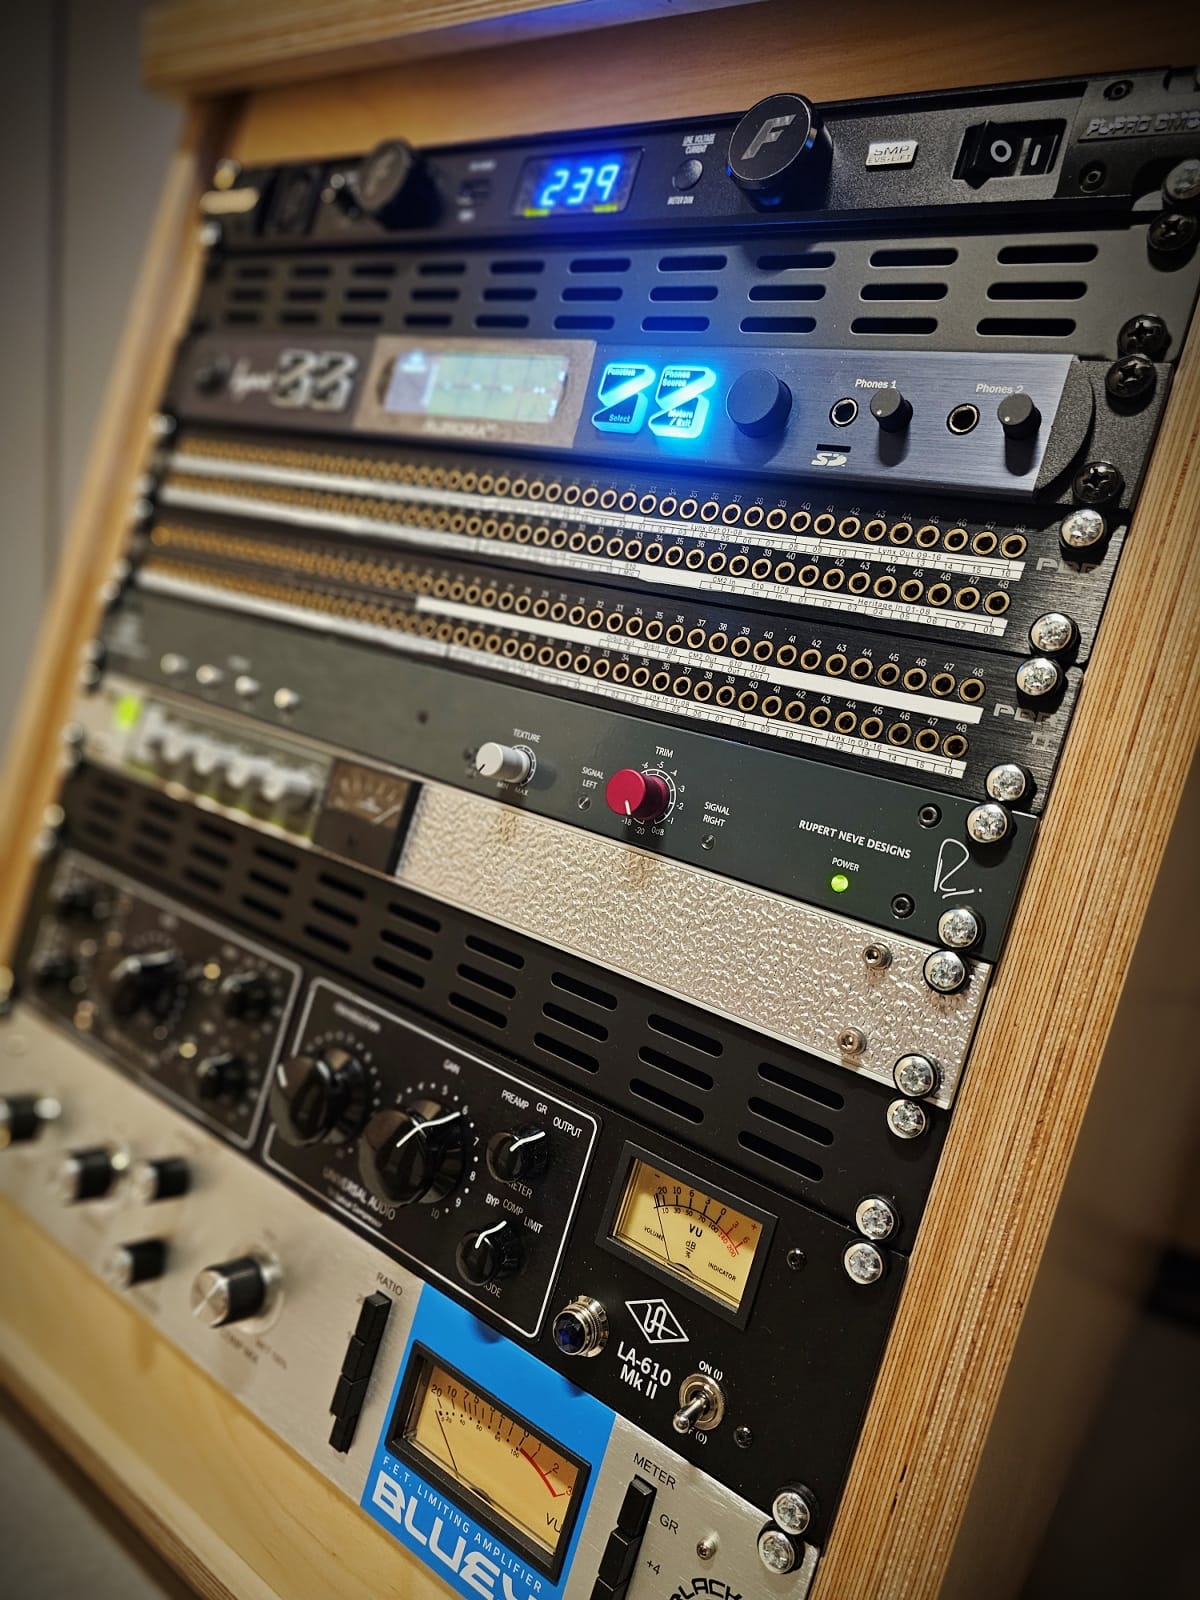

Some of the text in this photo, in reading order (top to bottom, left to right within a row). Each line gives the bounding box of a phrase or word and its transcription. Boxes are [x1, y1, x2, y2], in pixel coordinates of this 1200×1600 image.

[540, 163, 620, 207] 239
[855, 378, 897, 390] Phones 1
[975, 384, 1024, 394] Phones 2
[608, 414, 631, 422] Select
[850, 508, 860, 516] 42
[876, 510, 886, 519] 43
[902, 512, 912, 522] 44
[986, 522, 996, 530] 47
[878, 546, 898, 557] Lynx
[900, 550, 914, 559] Out
[696, 540, 705, 548] 36
[740, 546, 750, 554] 38
[763, 549, 772, 558] 39
[786, 552, 796, 560] 40
[812, 555, 820, 564] 41
[834, 558, 845, 568] 42
[860, 562, 870, 571] 43
[886, 564, 896, 574] 44
[912, 568, 924, 578] 45
[940, 572, 951, 582] 46
[968, 576, 980, 585] 47
[998, 580, 1009, 588] 48
[858, 599, 892, 610] Heritage
[676, 614, 984, 678] 36 37 38 39 40 41 42 43 44 45 46 47 48
[704, 655, 718, 663] Out
[662, 662, 968, 733] 36 37 38 39 40 41 42 43 44 45 46 47 48
[513, 728, 541, 743] TEXTURE
[655, 746, 674, 759] TRIM
[656, 760, 664, 769] -5
[582, 766, 604, 780] SIGNAL
[582, 779, 598, 790] LEFT
[678, 785, 685, 793] -3
[676, 802, 684, 810] -2
[704, 802, 730, 816] SIGNAL
[702, 814, 726, 828] RIGHT
[634, 826, 646, 836] -20
[651, 826, 665, 836] 0dB
[798, 819, 912, 860] RUPERT NEVE DESIGNS
[831, 856, 860, 872] POWER
[462, 1106, 469, 1116] 6
[501, 1089, 583, 1139] PREAMP GR OUTPUT
[474, 1137, 480, 1147] 7
[470, 1170, 476, 1182] 8
[658, 1186, 668, 1194] 20
[674, 1186, 682, 1194] 10
[368, 1196, 396, 1221] AUDIO
[456, 1198, 462, 1208] 9
[431, 1208, 440, 1220] 10
[486, 1192, 544, 1235] BYP COMP LIMIT
[689, 1224, 703, 1238] VU
[708, 1220, 719, 1233] 100
[644, 1226, 665, 1242] VOLUME
[685, 1240, 697, 1250] dB
[708, 1262, 737, 1282] INDICATOR
[376, 1272, 404, 1296] RATIO
[616, 1340, 672, 1387] LA-610
[698, 1360, 713, 1376] ON
[620, 1363, 659, 1400] Mk II
[431, 1384, 443, 1398] 20
[447, 1385, 458, 1398] 10
[510, 1448, 520, 1458] 100
[552, 1462, 560, 1474] 2
[633, 1452, 676, 1490] METER
[383, 1455, 542, 1594] F.E.T. LIMITING AMPLIFIER
[659, 1514, 680, 1535] GR
[646, 1560, 660, 1576] +4
